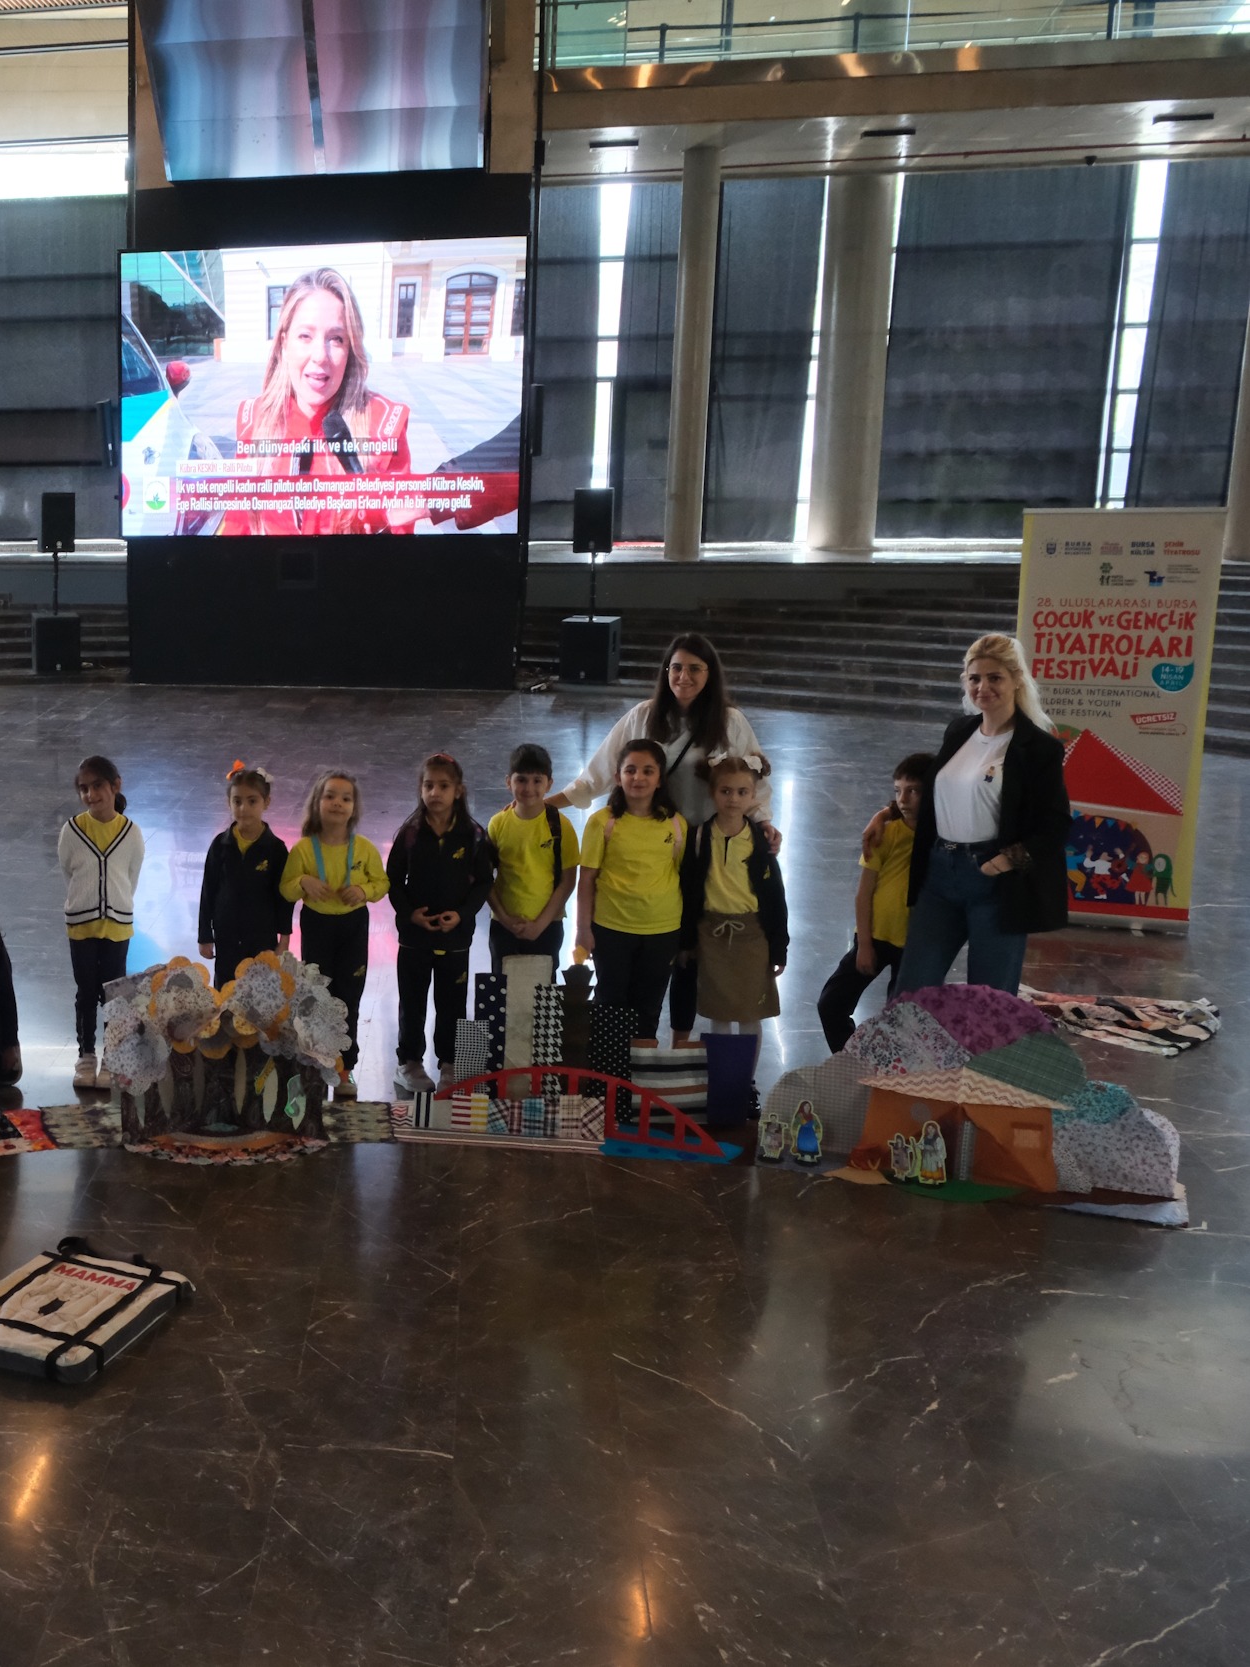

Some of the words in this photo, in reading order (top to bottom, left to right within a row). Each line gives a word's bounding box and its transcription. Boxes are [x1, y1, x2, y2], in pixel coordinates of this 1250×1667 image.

[237, 441, 256, 453] Ben
[258, 438, 311, 456] dünyadaki
[313, 439, 326, 453] ilk
[328, 442, 341, 452] ve
[343, 440, 360, 452] tek
[362, 439, 398, 455] engelli
[222, 462, 236, 472] Ralli
[236, 462, 253, 472] Pilotu
[176, 478, 185, 494] İlk
[186, 483, 196, 493] ve
[196, 480, 209, 493] tek
[210, 479, 235, 496] engelli
[235, 479, 257, 493] kadın
[257, 479, 273, 493] ralli
[273, 479, 295, 496] pilotu
[296, 479, 312, 493] olan
[313, 478, 355, 495] Osmangazi
[356, 477, 395, 495] Belediyesi
[395, 476, 432, 495] personeli
[432, 476, 455, 491] Kübra
[456, 476, 485, 493] Keskin,
[176, 497, 189, 514] Ege
[190, 497, 213, 511] Rallisi
[213, 497, 251, 511] öncesinde
[251, 496, 293, 514] Osmangazi
[294, 496, 326, 513] Belediye
[327, 496, 357, 513] Başkanı
[358, 496, 381, 509] Erkan
[382, 495, 404, 511] Aydın
[404, 495, 415, 509] ile
[415, 495, 427, 509] bir
[427, 498, 450, 512] araya
[450, 494, 472, 513] geldi.
[1130, 548, 1155, 556] KÜLTÜR
[1163, 548, 1201, 556] TİYATROSU
[1164, 541, 1184, 549] ŞEHİR
[1037, 597, 1054, 608] 28.
[1059, 598, 1151, 609] ULUSLARARASI
[1157, 599, 1198, 609] BURSA
[1032, 609, 1095, 631] ÇOCUK
[1098, 615, 1115, 627] VE
[1116, 609, 1198, 633] GENÇLİK
[1034, 632, 1194, 658] TİYATROLARI
[1031, 657, 1140, 681] FESTİVALİ
[1053, 688, 1082, 696] BURSA
[1087, 688, 1162, 699] INTERNATIONAL
[1045, 709, 1067, 717] ATRE
[1071, 709, 1113, 718] FESTIVAL
[54, 1264, 137, 1292] MAMMA
